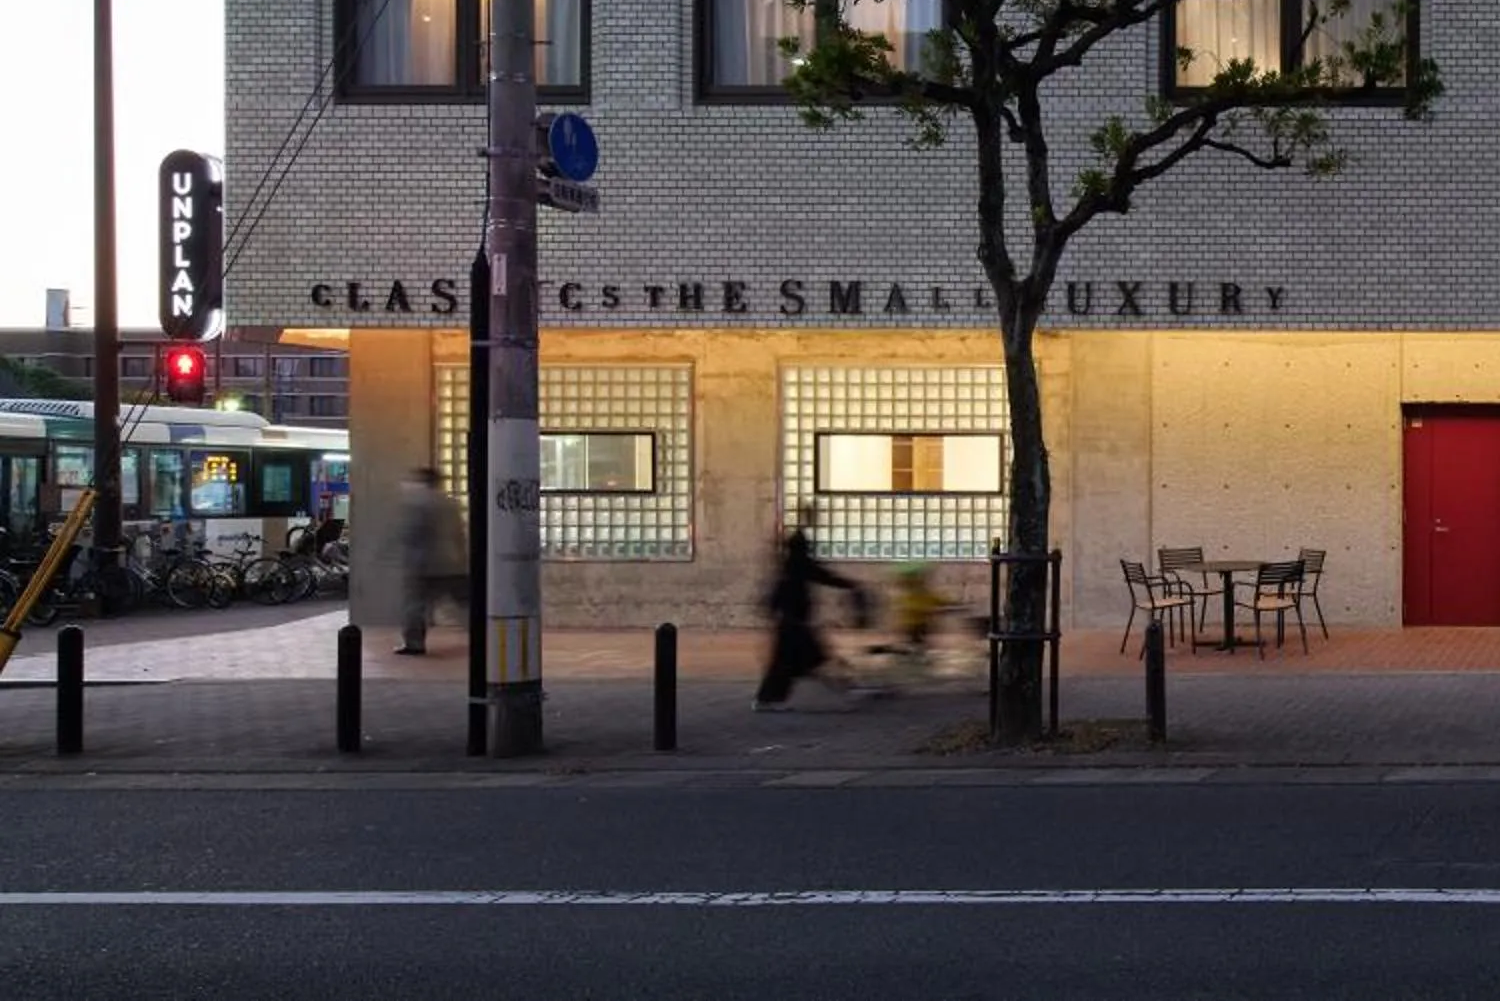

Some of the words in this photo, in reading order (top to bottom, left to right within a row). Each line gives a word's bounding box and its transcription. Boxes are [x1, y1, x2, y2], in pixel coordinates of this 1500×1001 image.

[172, 172, 194, 317] UNPLAN
[311, 279, 620, 314] CLASCS
[644, 280, 747, 313] THE
[779, 278, 992, 316] SMALL
[1043, 280, 1286, 315] UXURY
